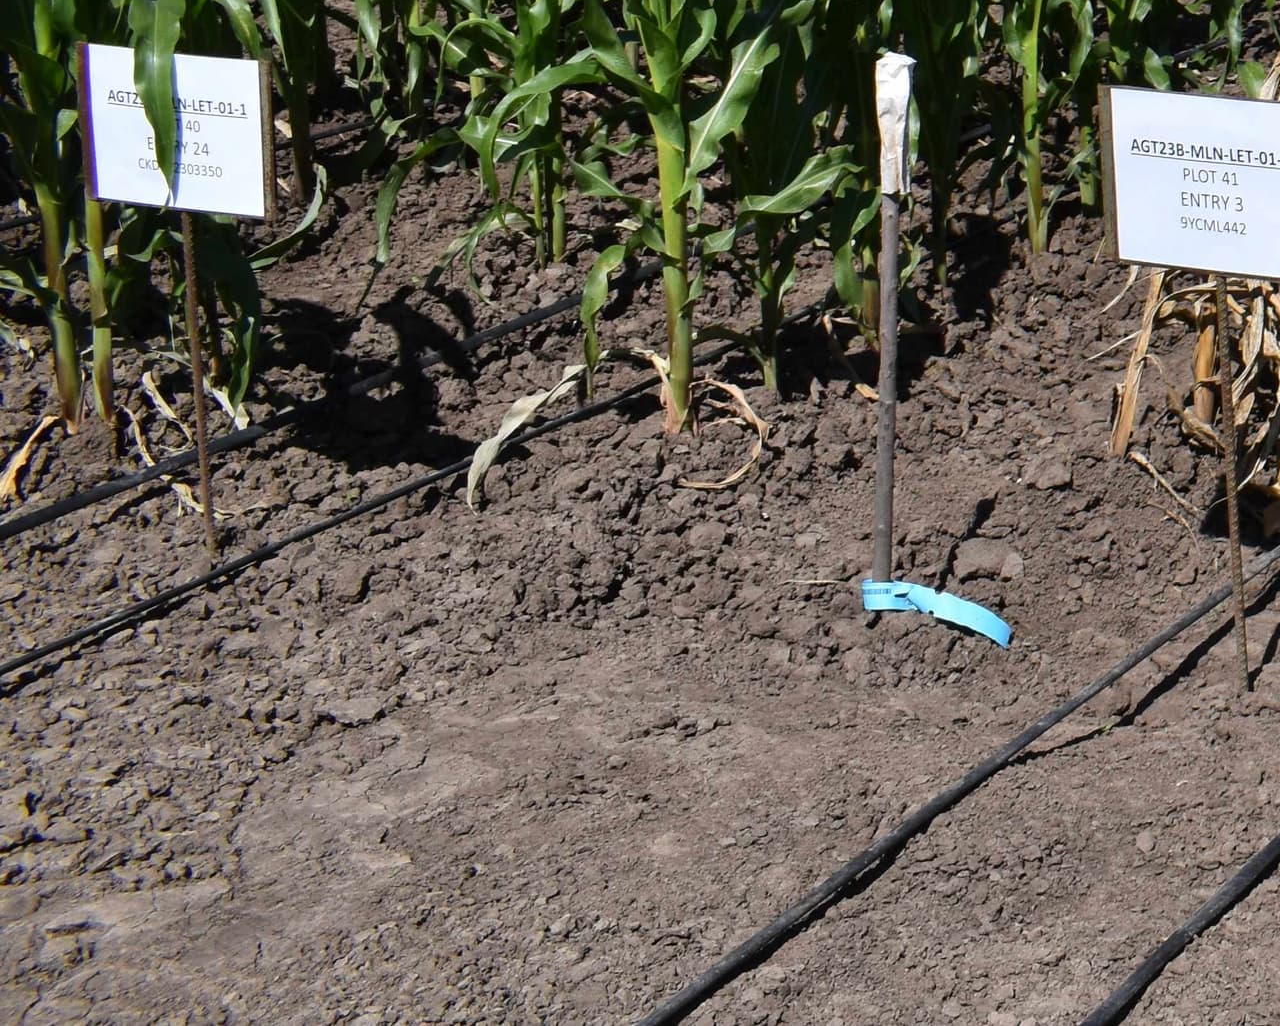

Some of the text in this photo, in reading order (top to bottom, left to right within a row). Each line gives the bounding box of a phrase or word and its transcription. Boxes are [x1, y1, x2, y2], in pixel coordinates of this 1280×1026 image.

[185, 120, 201, 133] 40
[193, 142, 209, 156] 24
[1183, 168, 1240, 186] PLOT 41
[1181, 191, 1244, 212] ENTRY 3
[1180, 216, 1247, 235] 9YCML442
